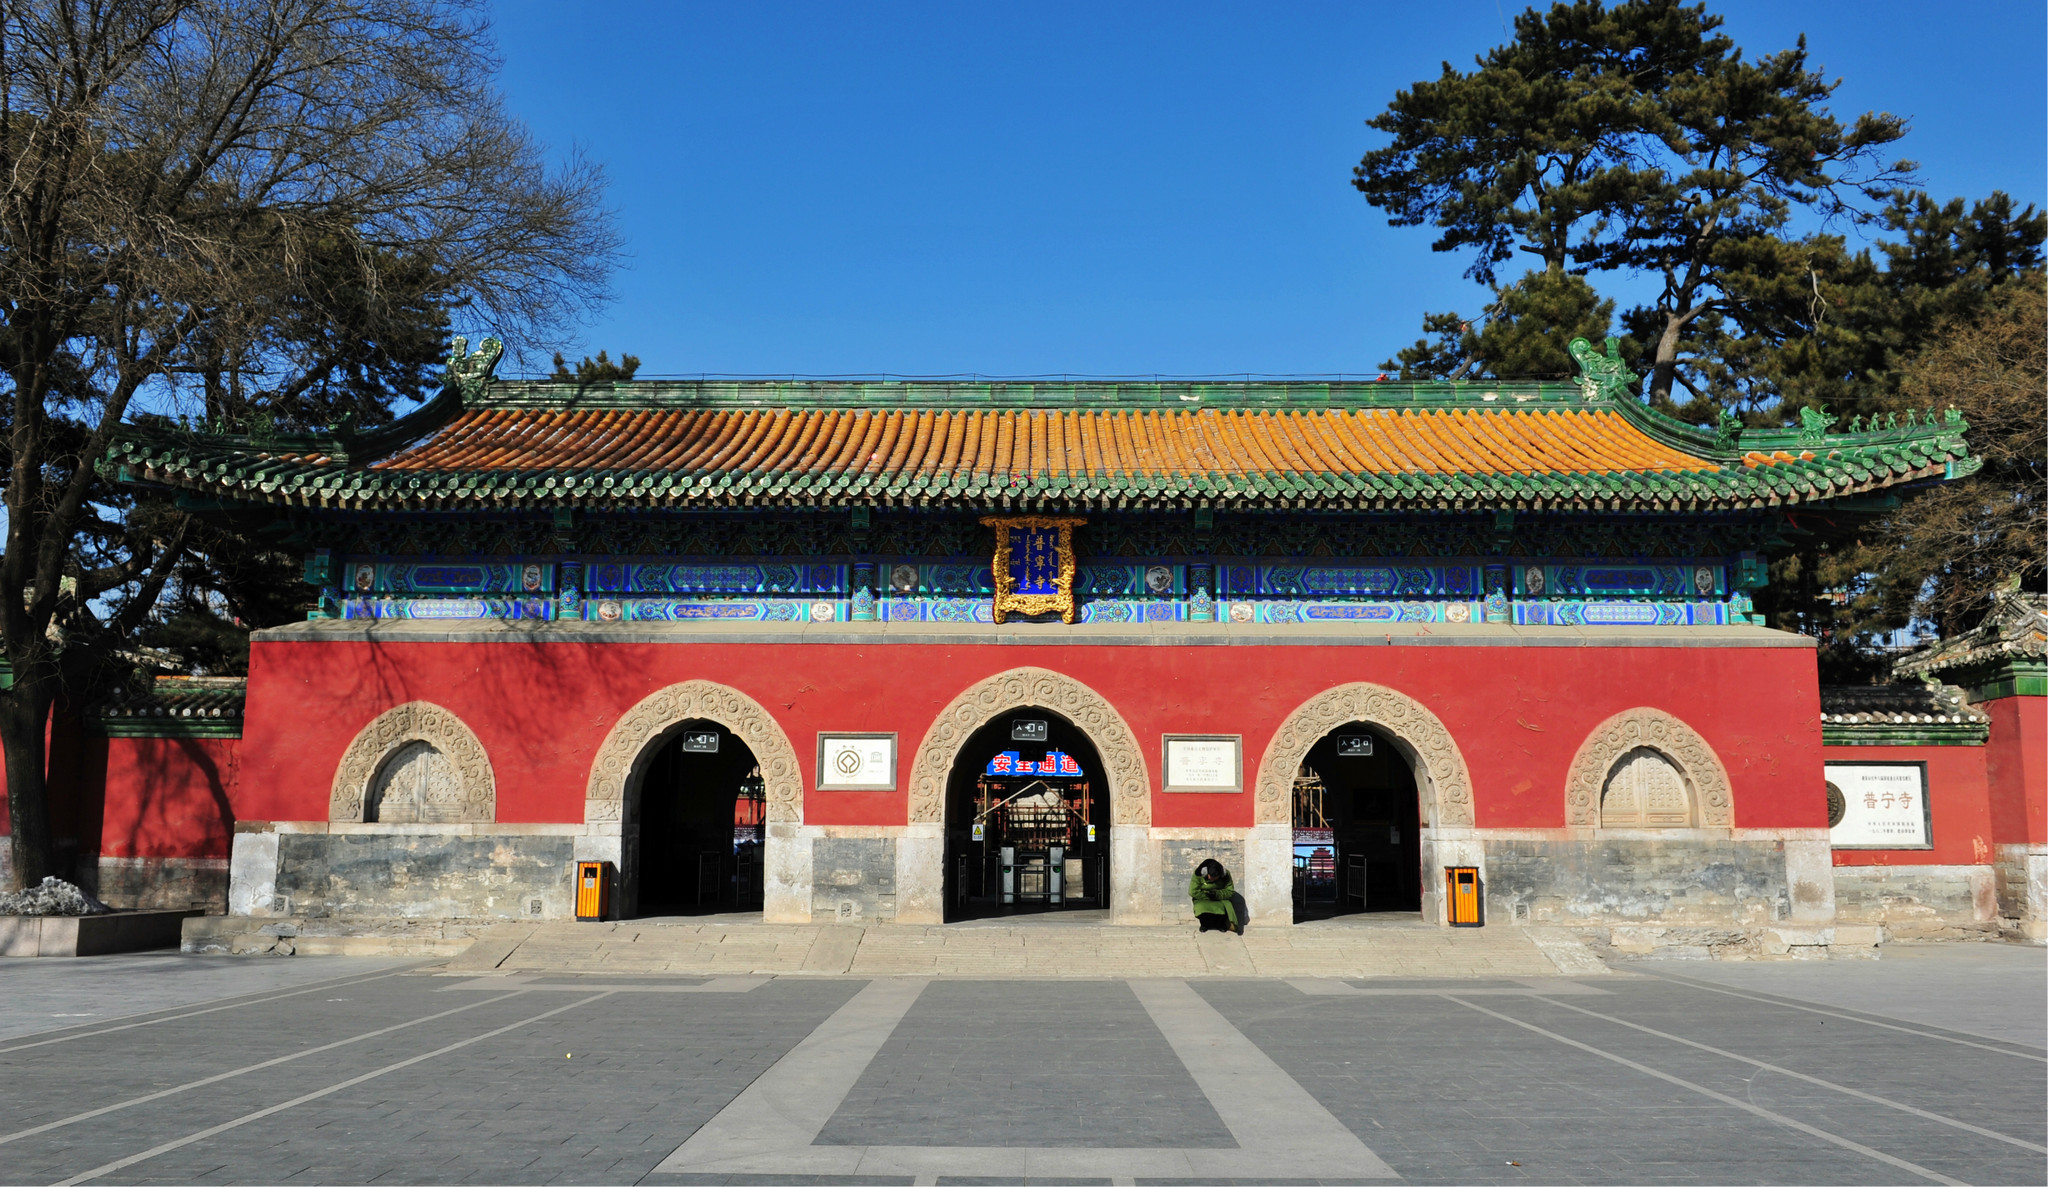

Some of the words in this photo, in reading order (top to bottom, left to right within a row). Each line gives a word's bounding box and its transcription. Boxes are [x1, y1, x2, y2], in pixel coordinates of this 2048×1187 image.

[1033, 534, 1046, 590] 普寧寺
[993, 755, 1079, 773] 安全通道
[1863, 791, 1913, 810] 普宁寺
